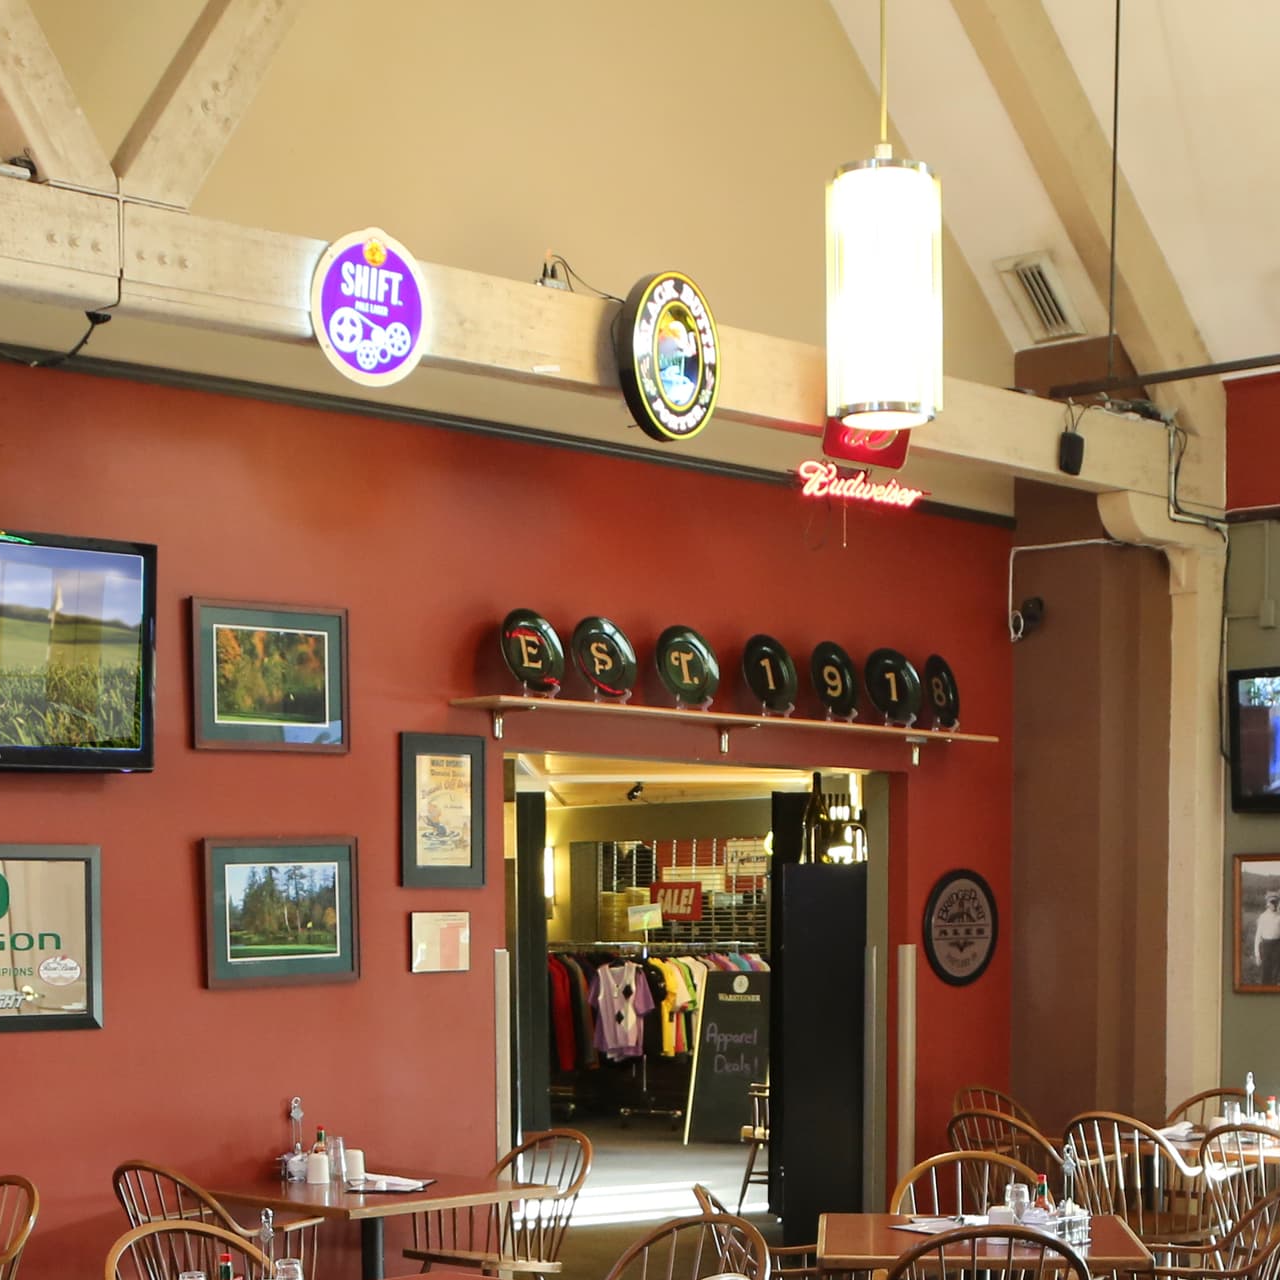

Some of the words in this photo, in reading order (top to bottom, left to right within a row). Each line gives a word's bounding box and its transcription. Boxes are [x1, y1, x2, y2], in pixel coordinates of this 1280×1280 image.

[340, 261, 403, 306] SHIFT
[799, 460, 923, 507] Budweiser
[759, 657, 947, 707] 1918
[656, 887, 696, 915] SALE!
[706, 1022, 758, 1053] Apparel
[714, 1053, 758, 1075] Deals!
